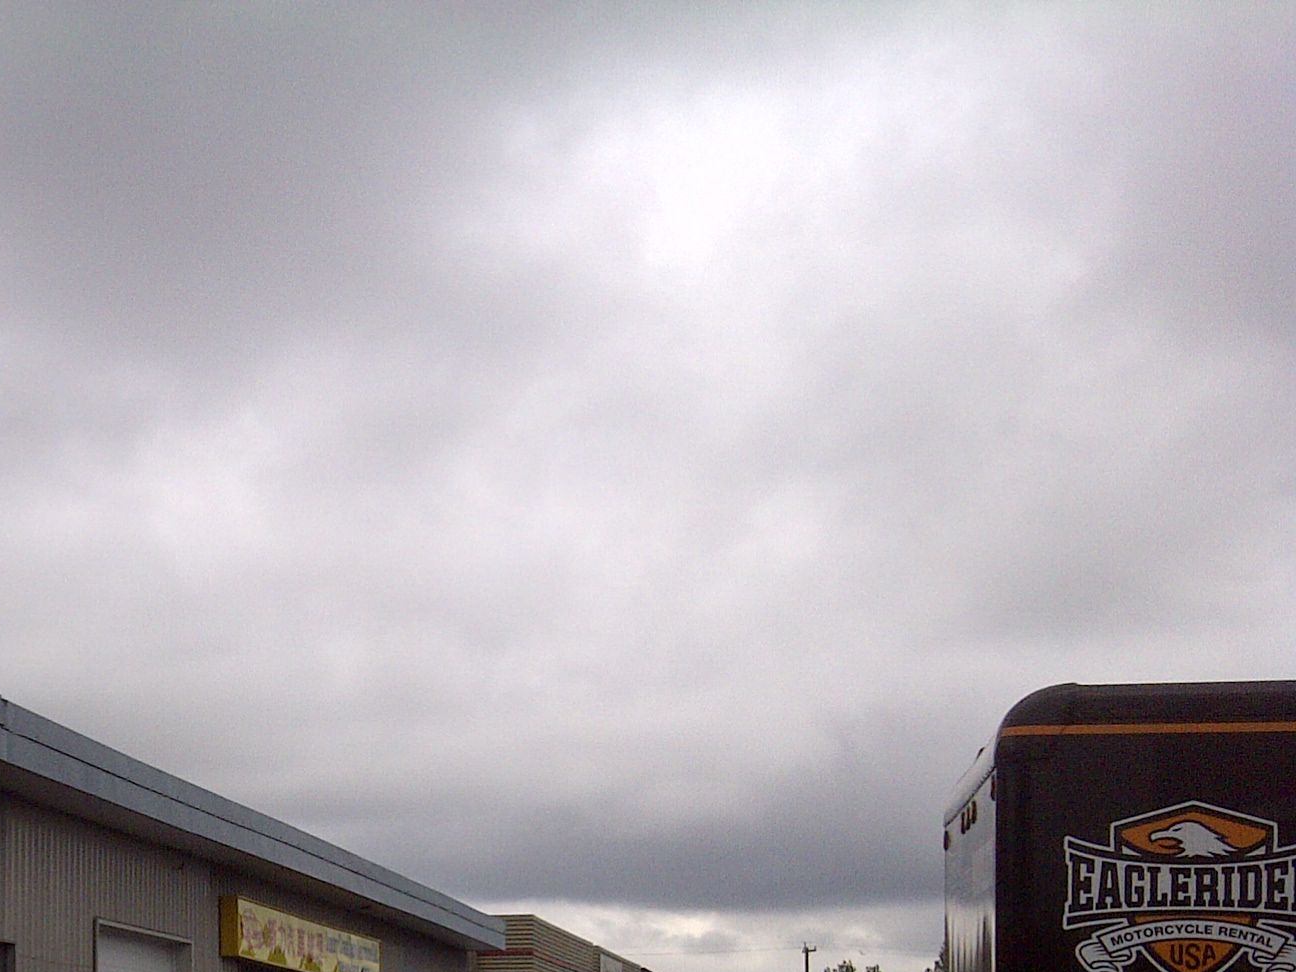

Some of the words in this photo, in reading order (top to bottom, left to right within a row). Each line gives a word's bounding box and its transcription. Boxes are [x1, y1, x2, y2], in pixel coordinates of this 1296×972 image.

[1068, 852, 1296, 914] EAGLERIDE
[1110, 924, 1213, 947] MOTORCYCLE
[1218, 926, 1274, 948] RENTAL
[1170, 943, 1217, 971] USA
